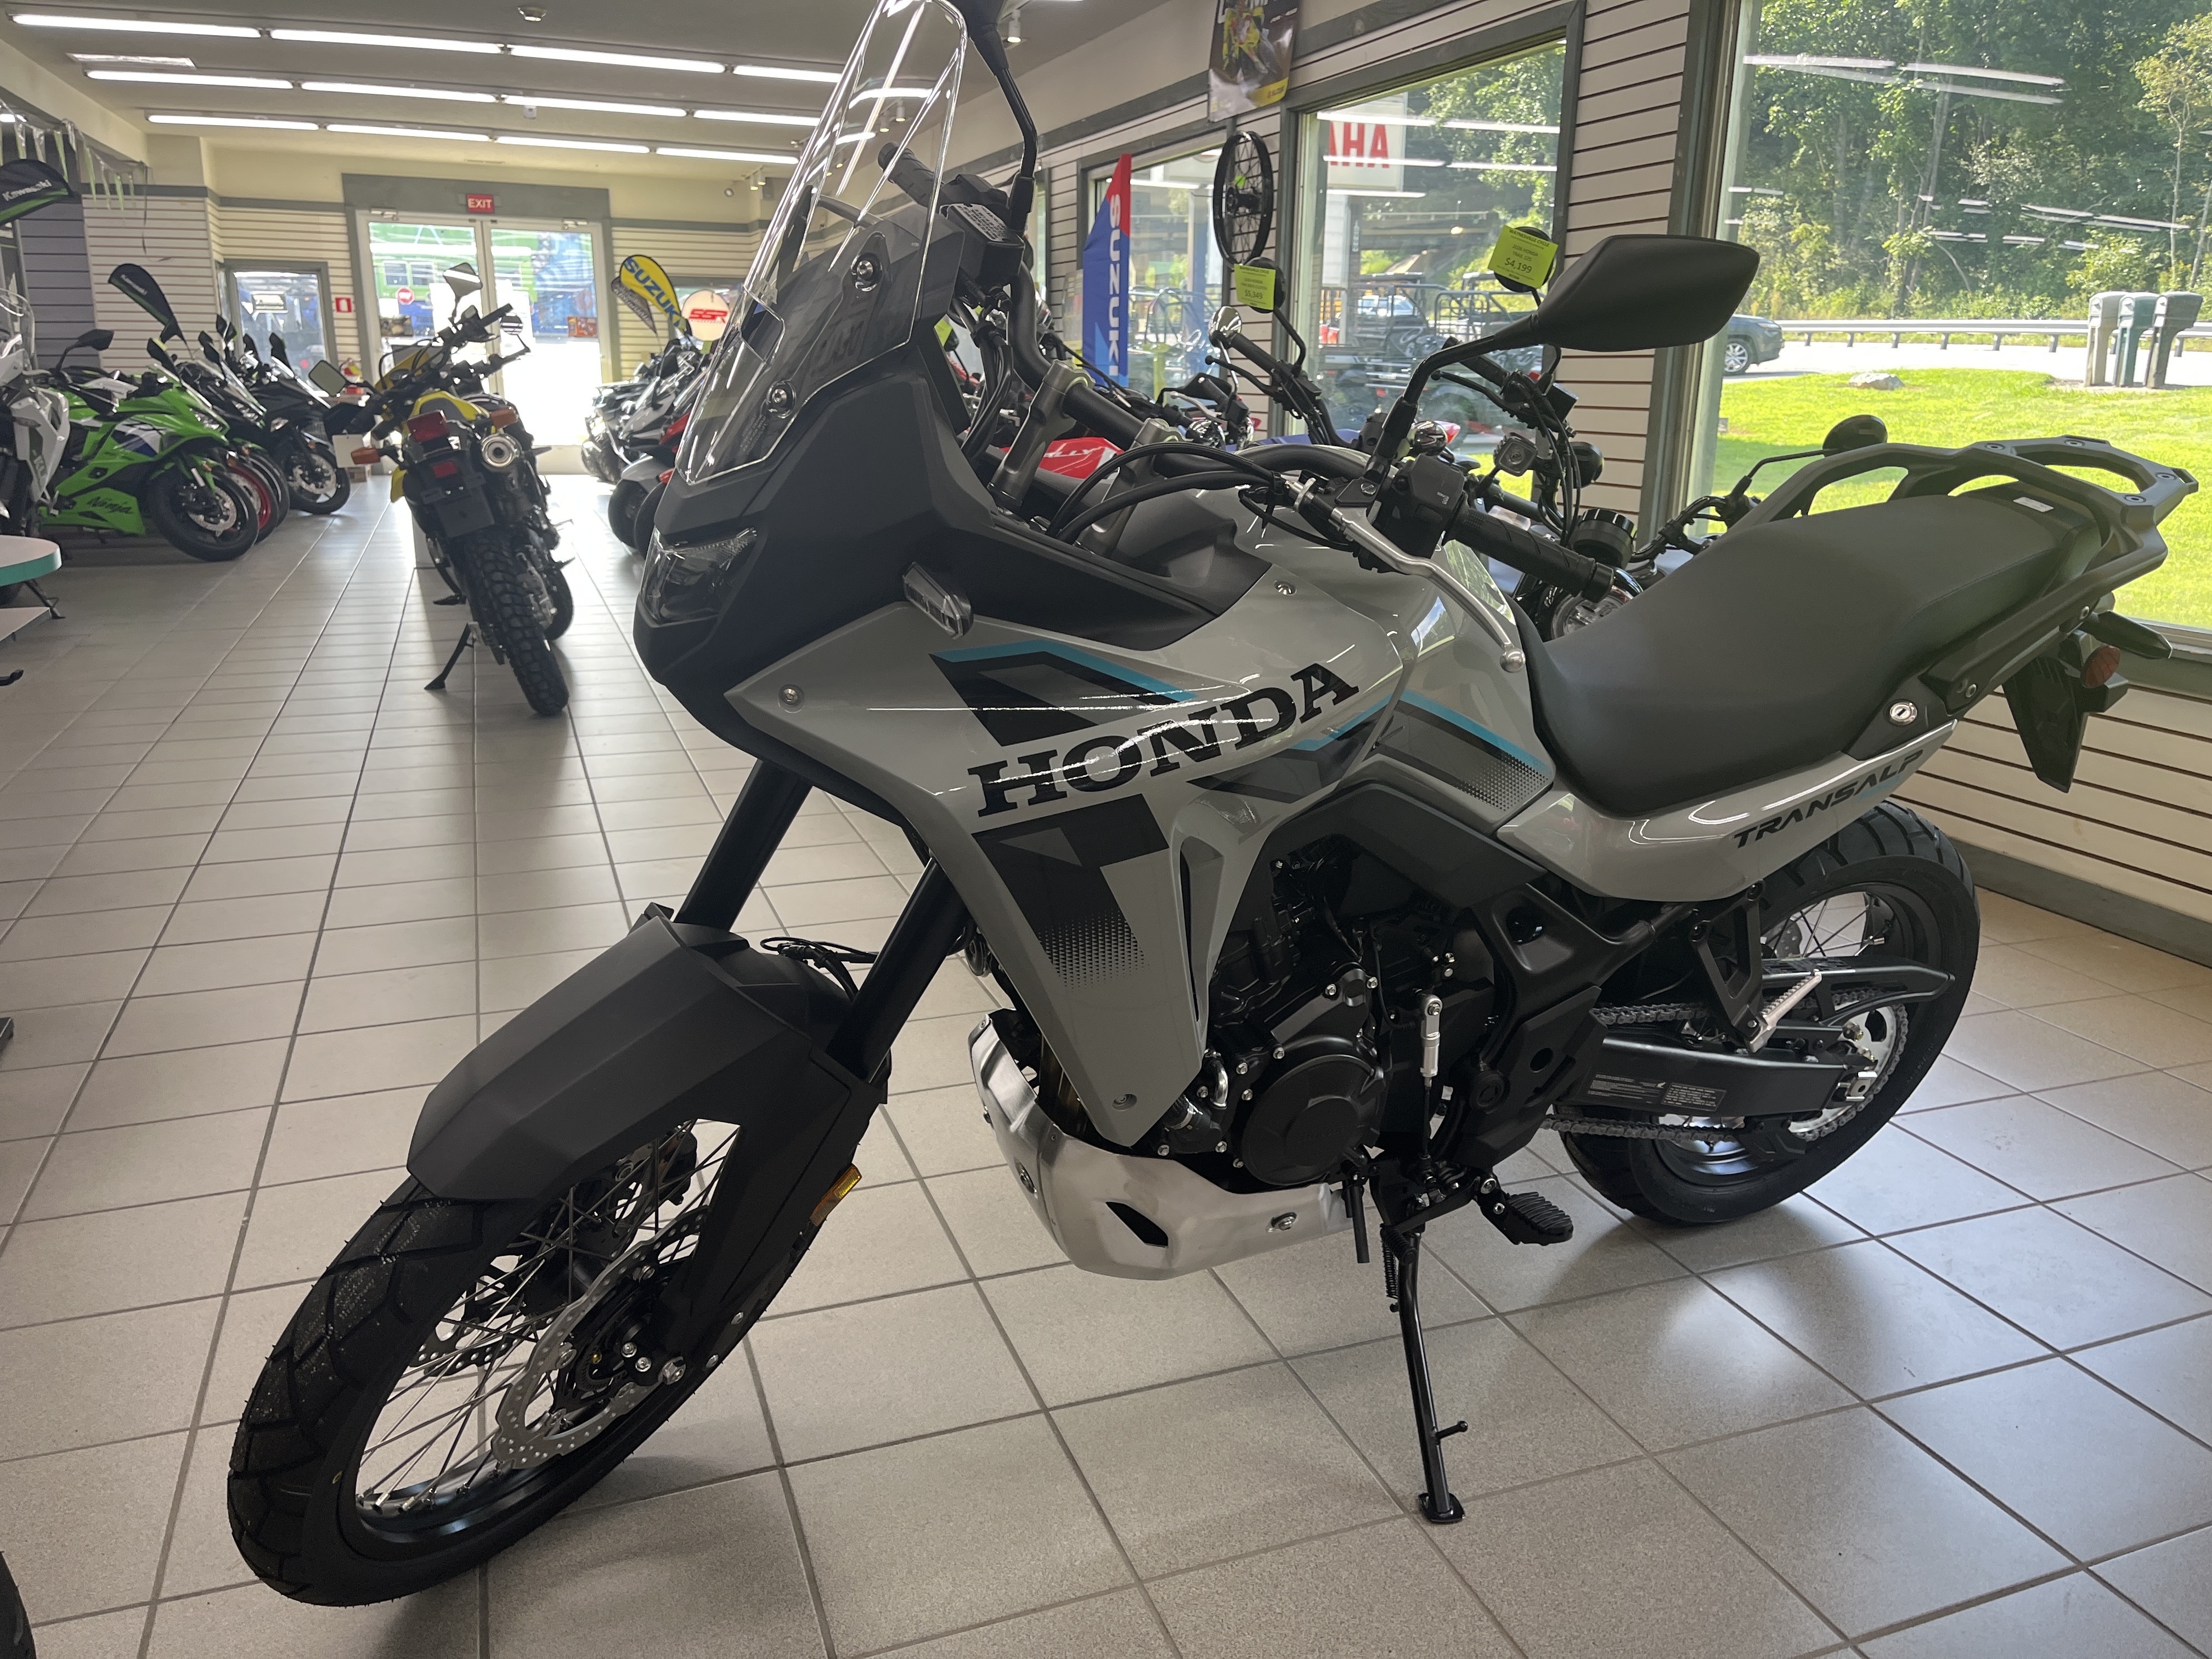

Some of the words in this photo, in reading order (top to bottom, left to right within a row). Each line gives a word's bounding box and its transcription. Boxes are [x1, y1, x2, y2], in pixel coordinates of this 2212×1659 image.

[467, 198, 493, 208] EXIT
[1504, 257, 1532, 273] $4,199
[1108, 194, 1121, 377] SUZUKI
[1244, 289, 1263, 300] $5,349
[689, 308, 729, 324] SSR
[967, 663, 1359, 817] HONDA
[1734, 749, 1923, 848] TRANSALP
